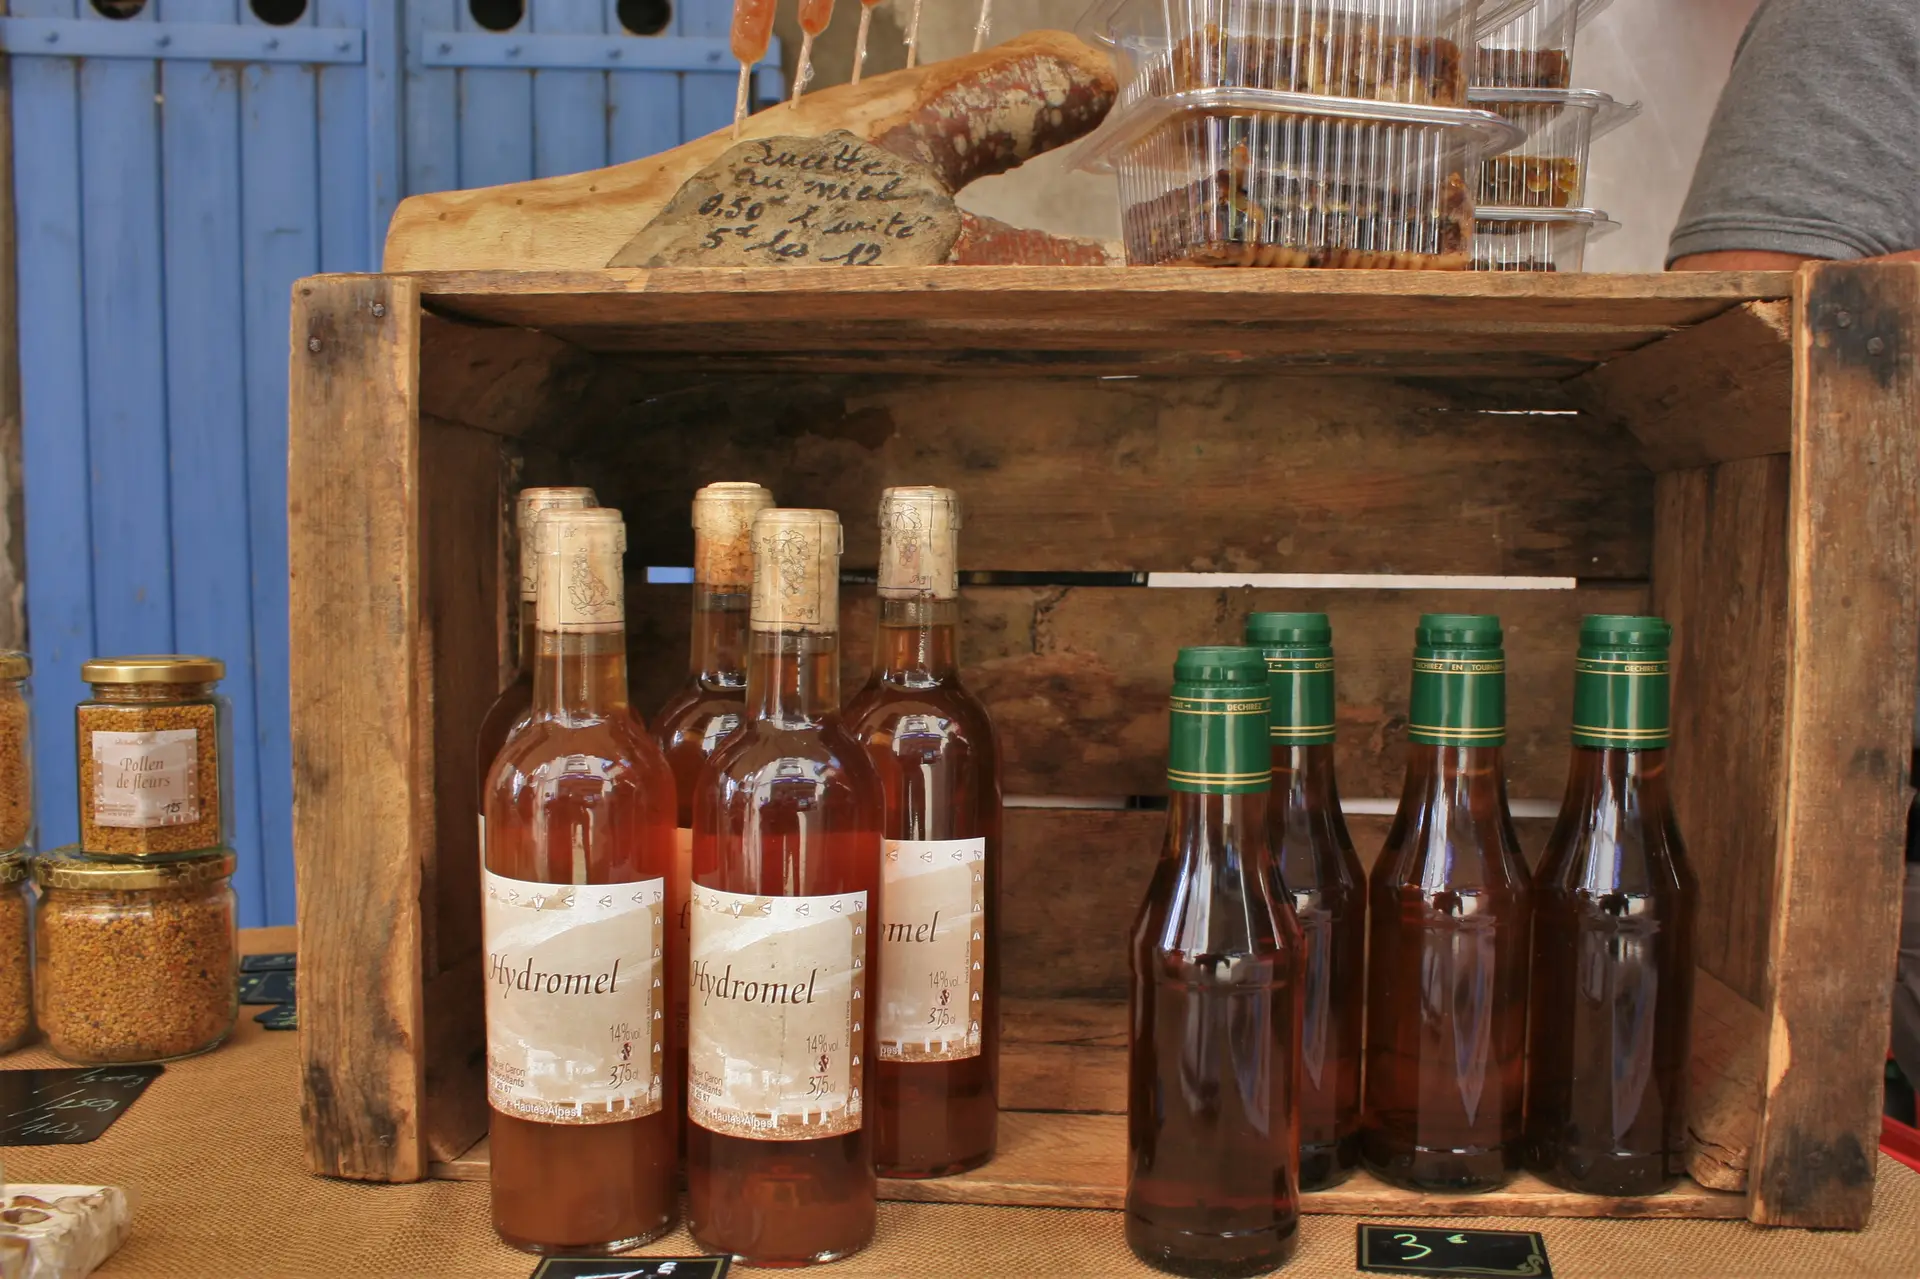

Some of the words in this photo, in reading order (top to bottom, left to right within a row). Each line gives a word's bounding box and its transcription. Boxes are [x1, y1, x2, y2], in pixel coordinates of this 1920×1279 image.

[804, 176, 908, 201] miel
[744, 229, 809, 258] les
[1451, 663, 1463, 671] EN
[1227, 702, 1262, 711] DECHIREZ
[119, 755, 164, 772] Pollen
[116, 773, 130, 789] de
[130, 773, 171, 795] fleurs
[882, 910, 940, 943] mel
[489, 952, 621, 999] Hydromel
[691, 959, 818, 1006] Hydromel
[929, 970, 949, 988] 14%
[609, 1022, 629, 1042] 14%
[806, 1034, 828, 1053] 14%
[505, 1062, 526, 1077] Caron
[704, 1071, 723, 1086] Caron
